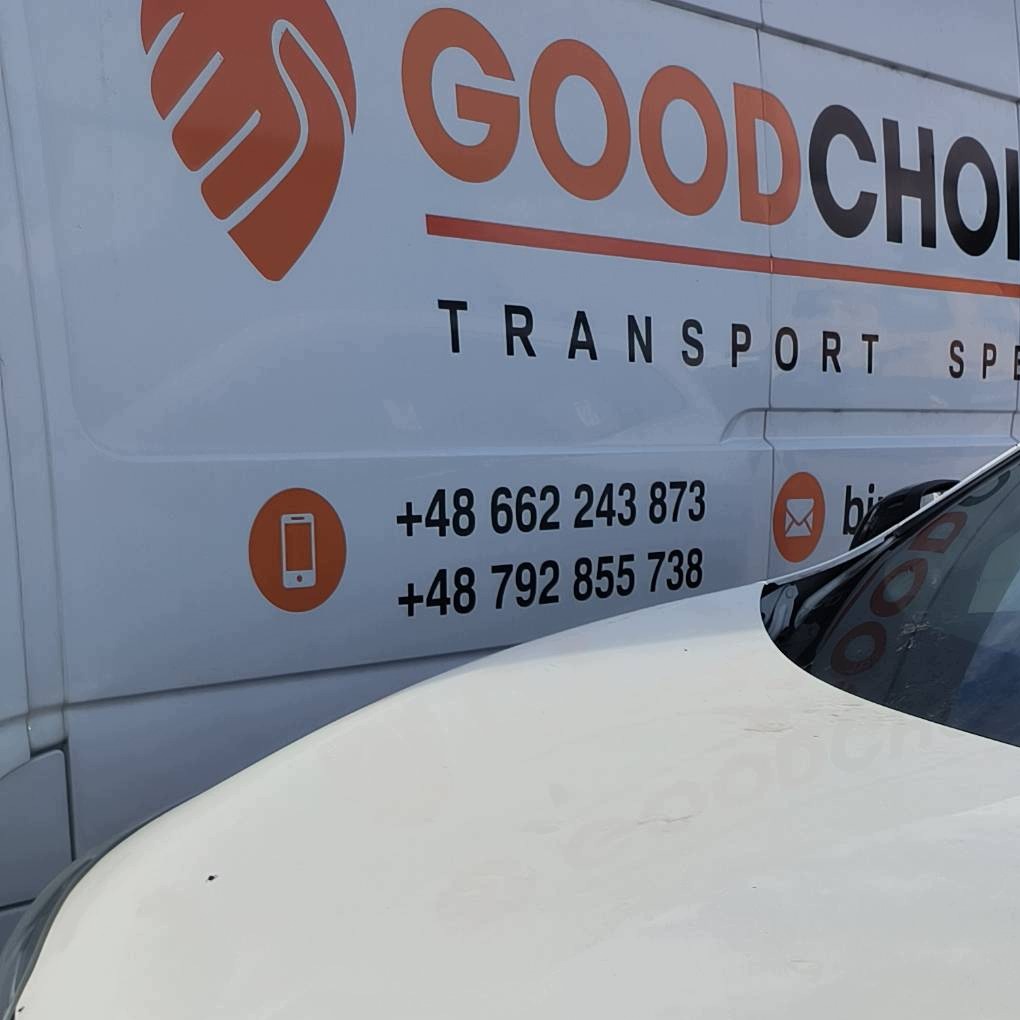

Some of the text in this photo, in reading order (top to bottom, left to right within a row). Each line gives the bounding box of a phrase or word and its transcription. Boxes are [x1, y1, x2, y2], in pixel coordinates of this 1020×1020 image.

[437, 299, 880, 374] TRANSPORT
[396, 480, 706, 537] +48 662 243 873
[843, 483, 884, 536] bi
[397, 548, 703, 617] +48 792 855 738
